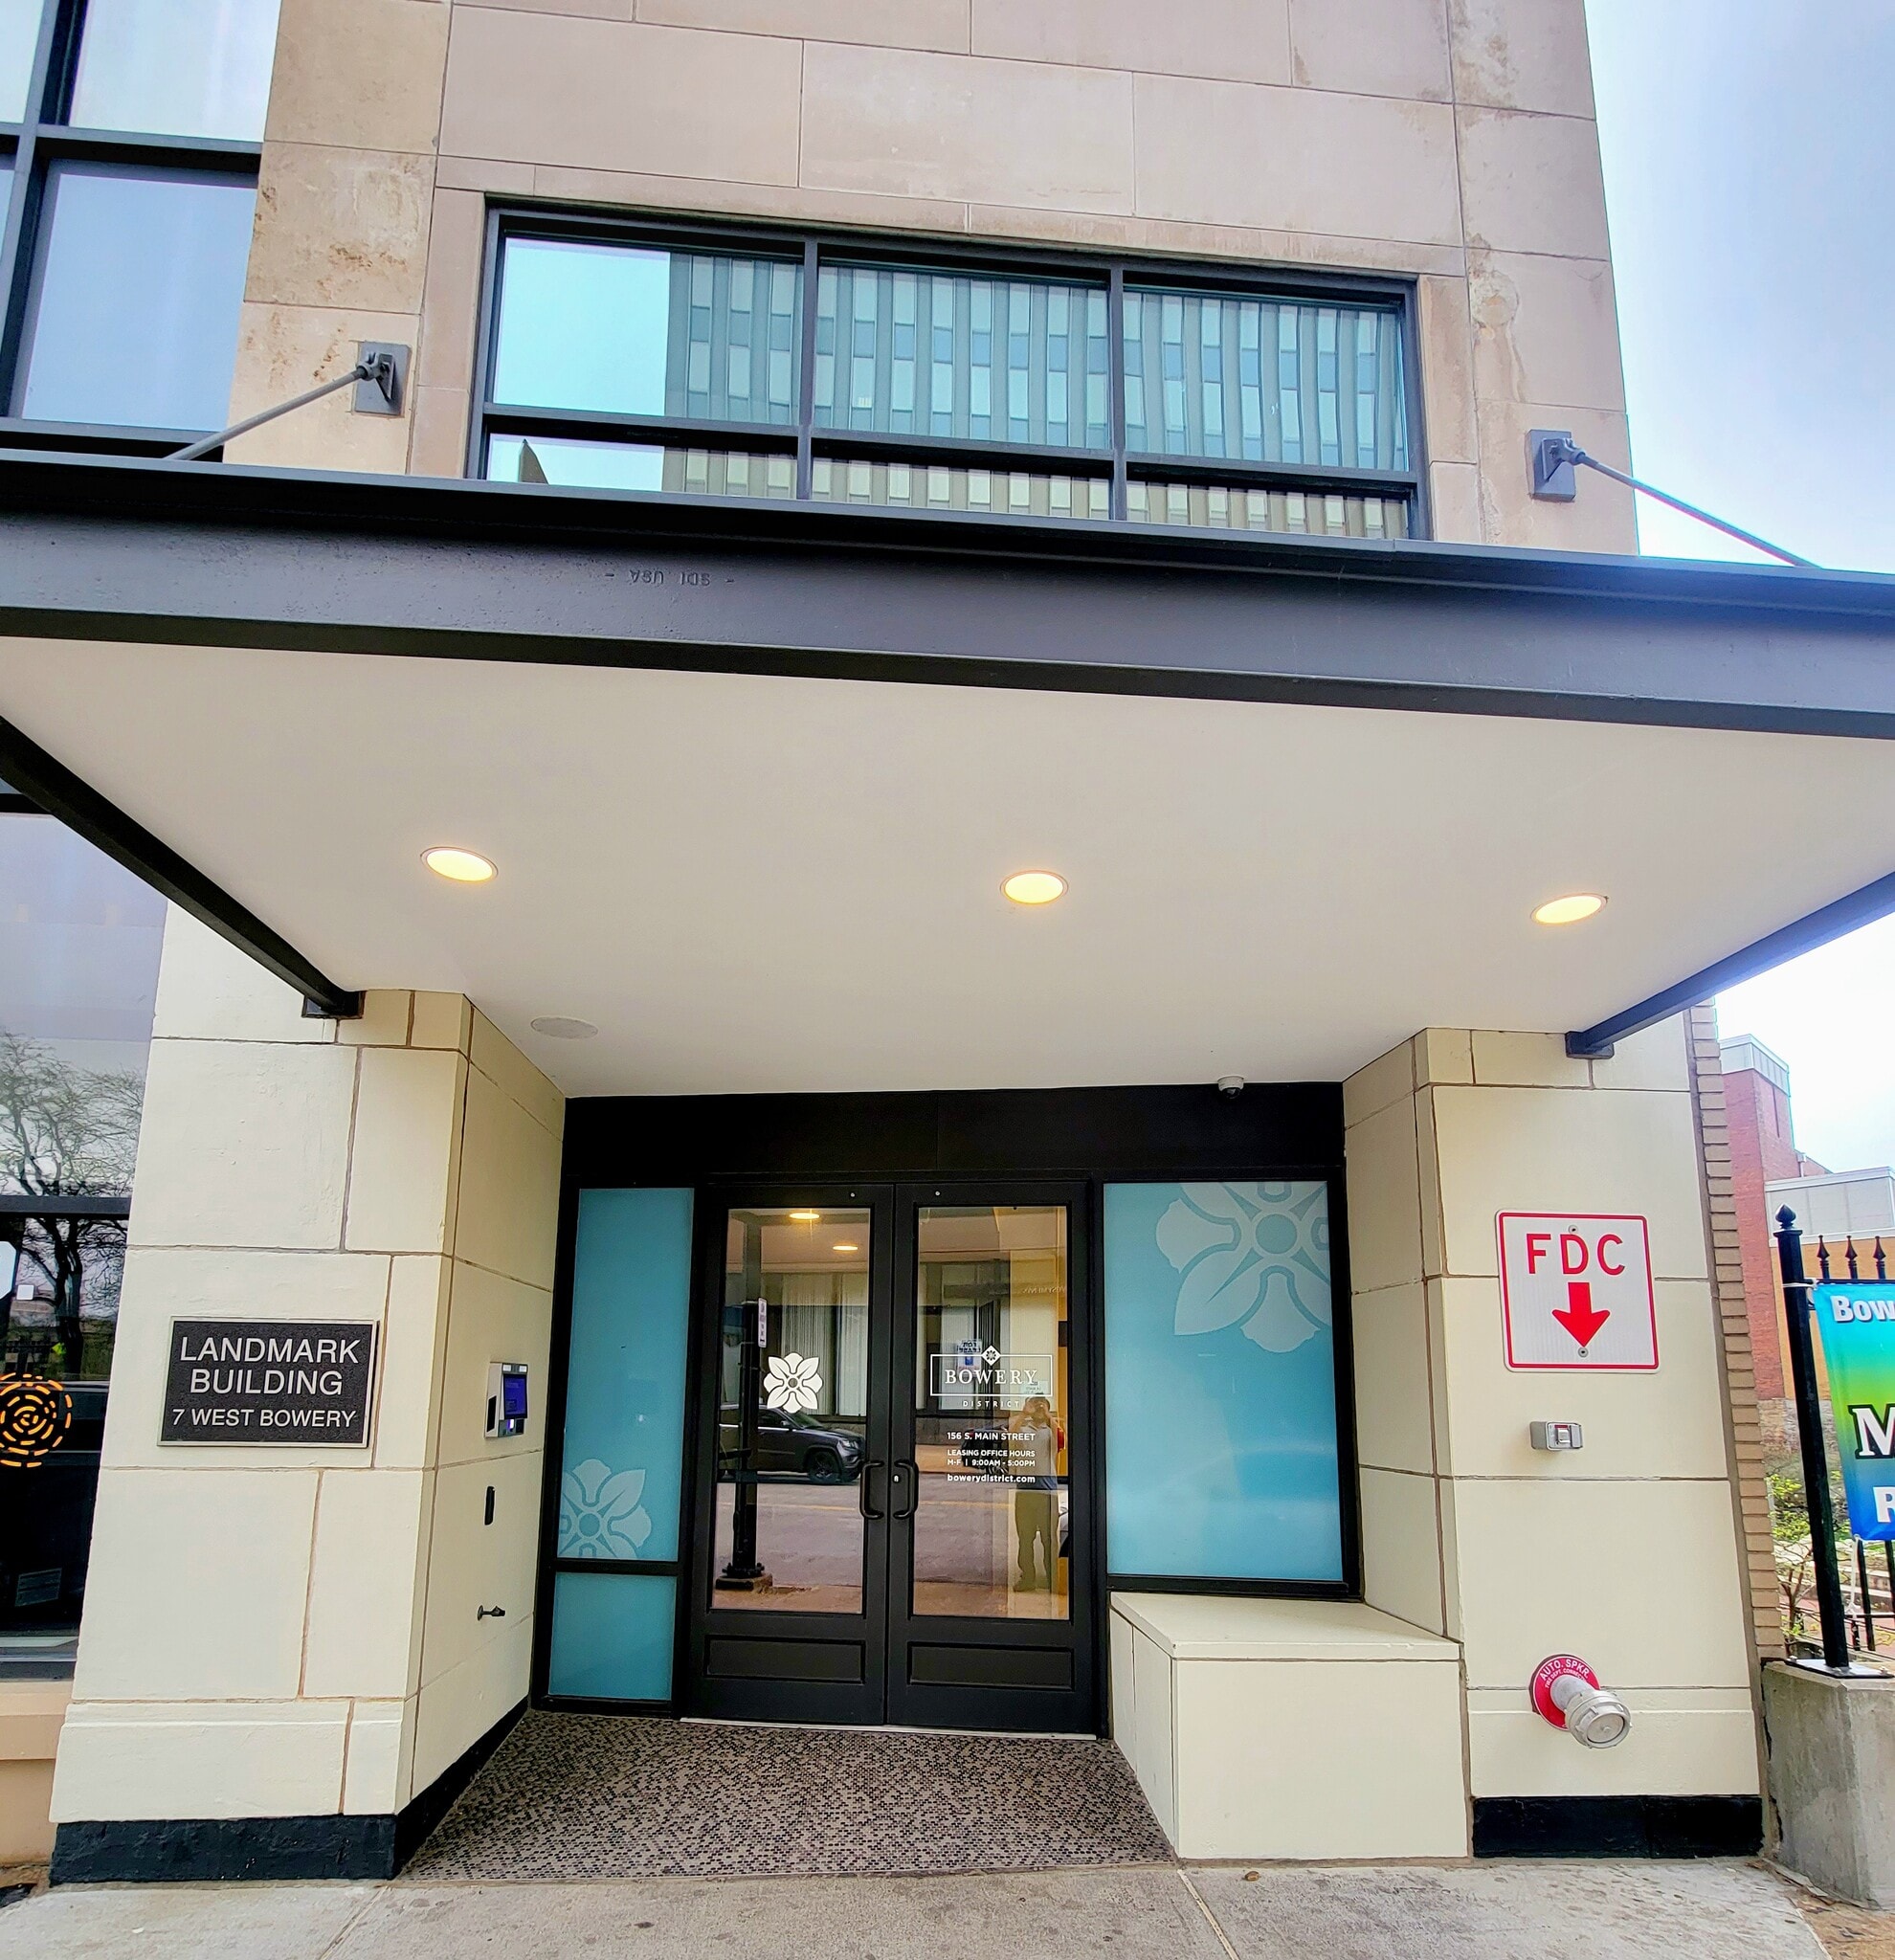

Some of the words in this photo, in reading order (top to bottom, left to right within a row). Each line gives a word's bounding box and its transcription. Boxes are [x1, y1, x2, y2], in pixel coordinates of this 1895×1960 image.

[629, 569, 664, 585] USA
[680, 572, 711, 587] SDI
[1526, 1233, 1625, 1276] FDC
[180, 1336, 361, 1365] LANDMARK
[190, 1369, 343, 1395] BUILDING
[945, 1369, 1037, 1385] BOWERY
[172, 1409, 186, 1426] 7
[191, 1409, 255, 1427] WEST
[259, 1410, 357, 1428] BOWERY
[947, 1432, 962, 1440] 156
[964, 1432, 972, 1440] S.
[974, 1432, 999, 1440] MAIN
[1001, 1433, 1036, 1441] STREET
[947, 1474, 1036, 1483] bowerydistrict.com
